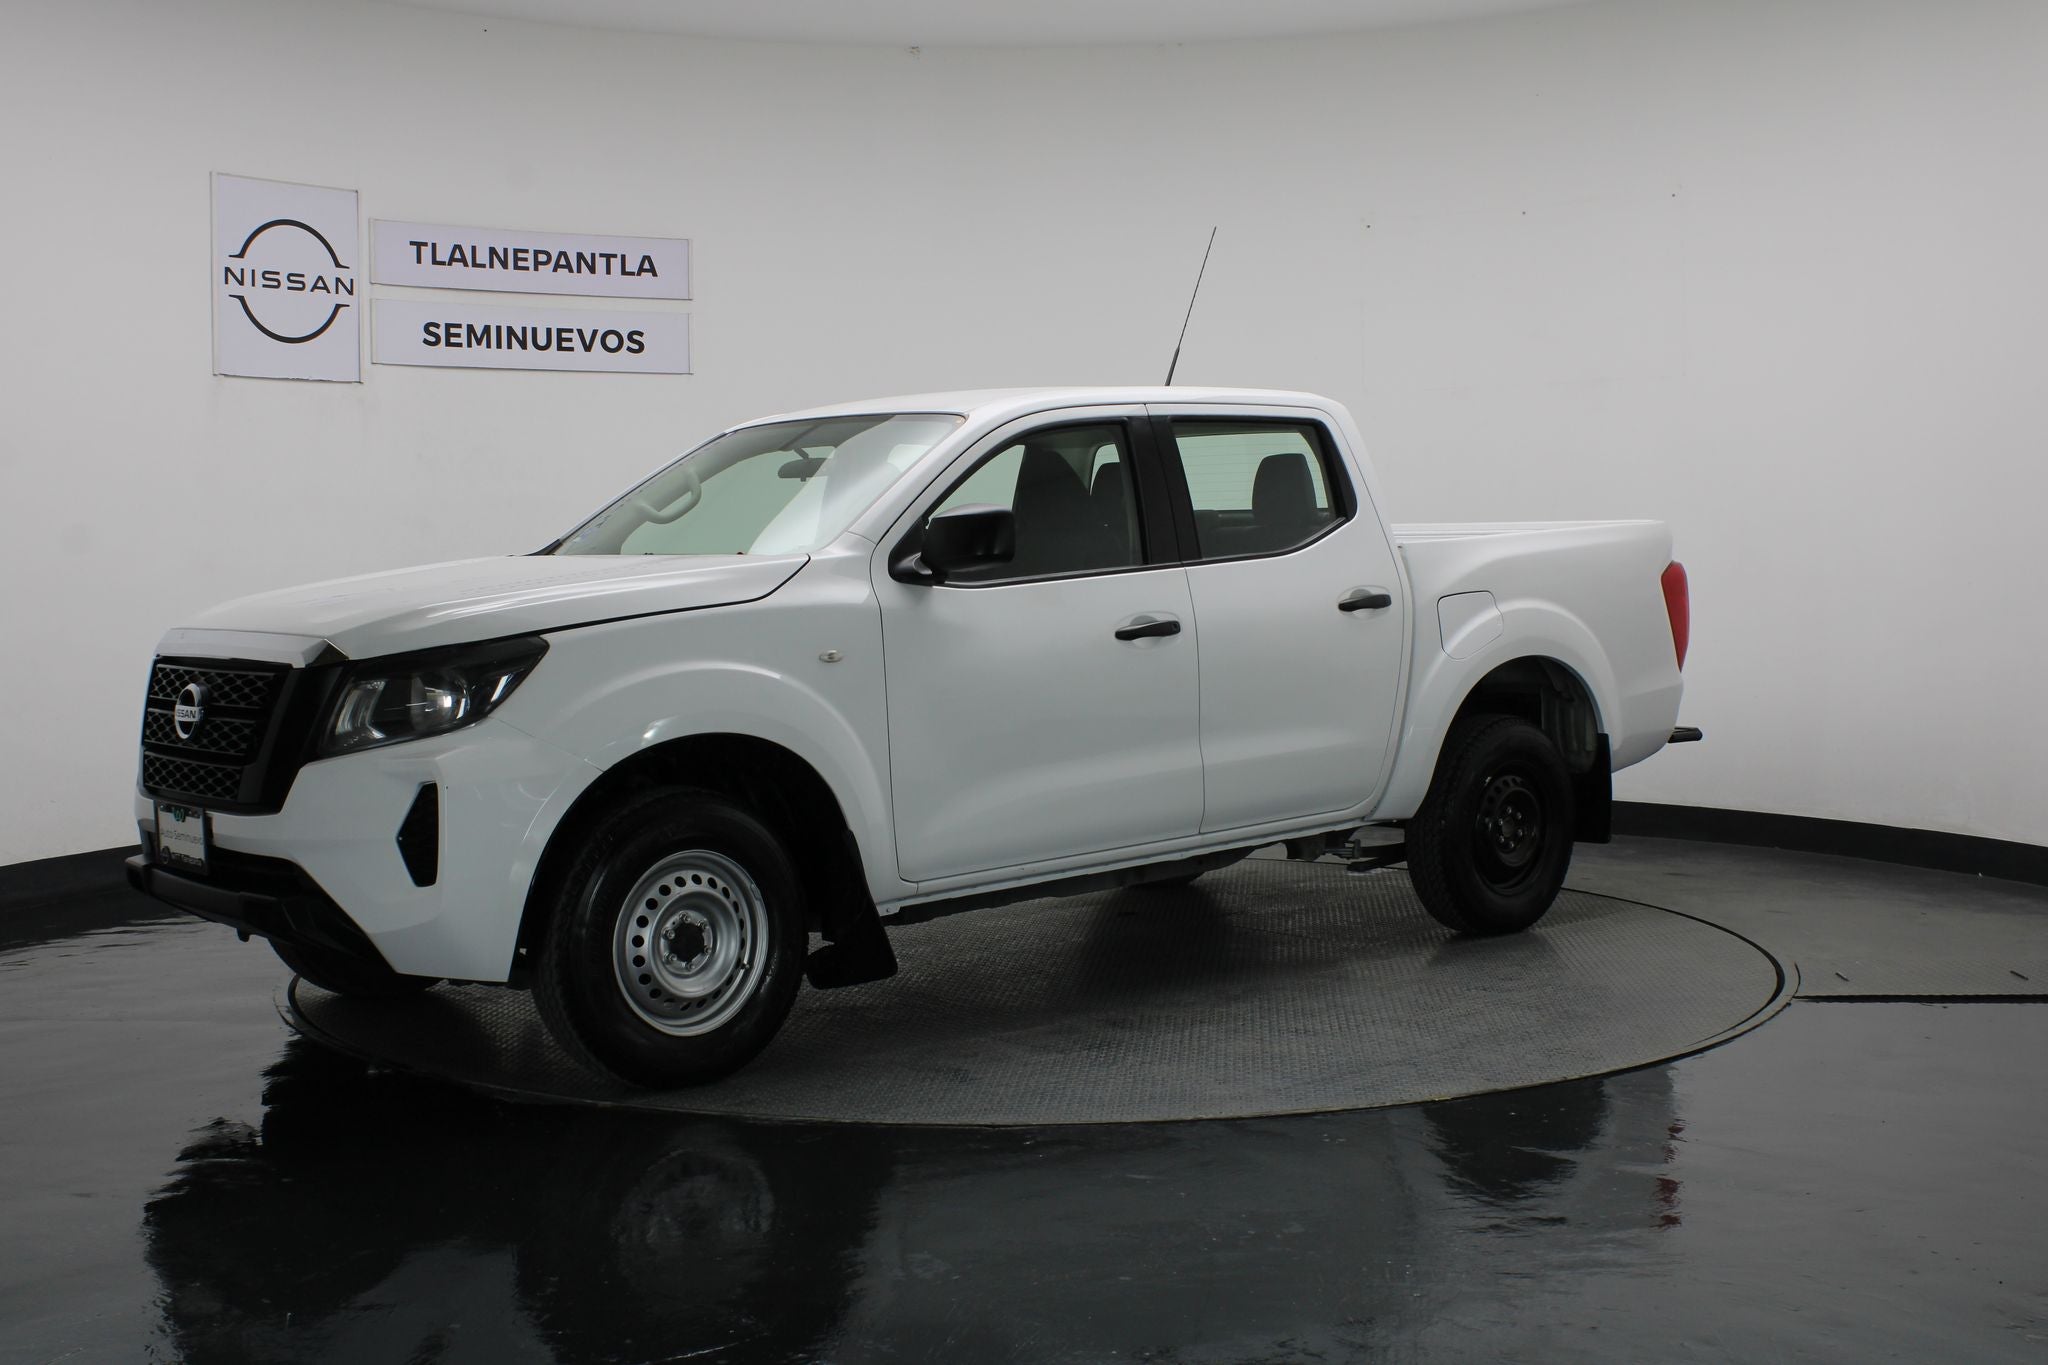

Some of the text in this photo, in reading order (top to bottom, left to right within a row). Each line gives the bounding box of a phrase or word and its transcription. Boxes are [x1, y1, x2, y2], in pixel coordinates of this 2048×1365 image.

[409, 240, 658, 278] TLALNEPANTLA
[224, 266, 354, 297] NISSAN
[422, 321, 646, 355] SEMINUEVOS
